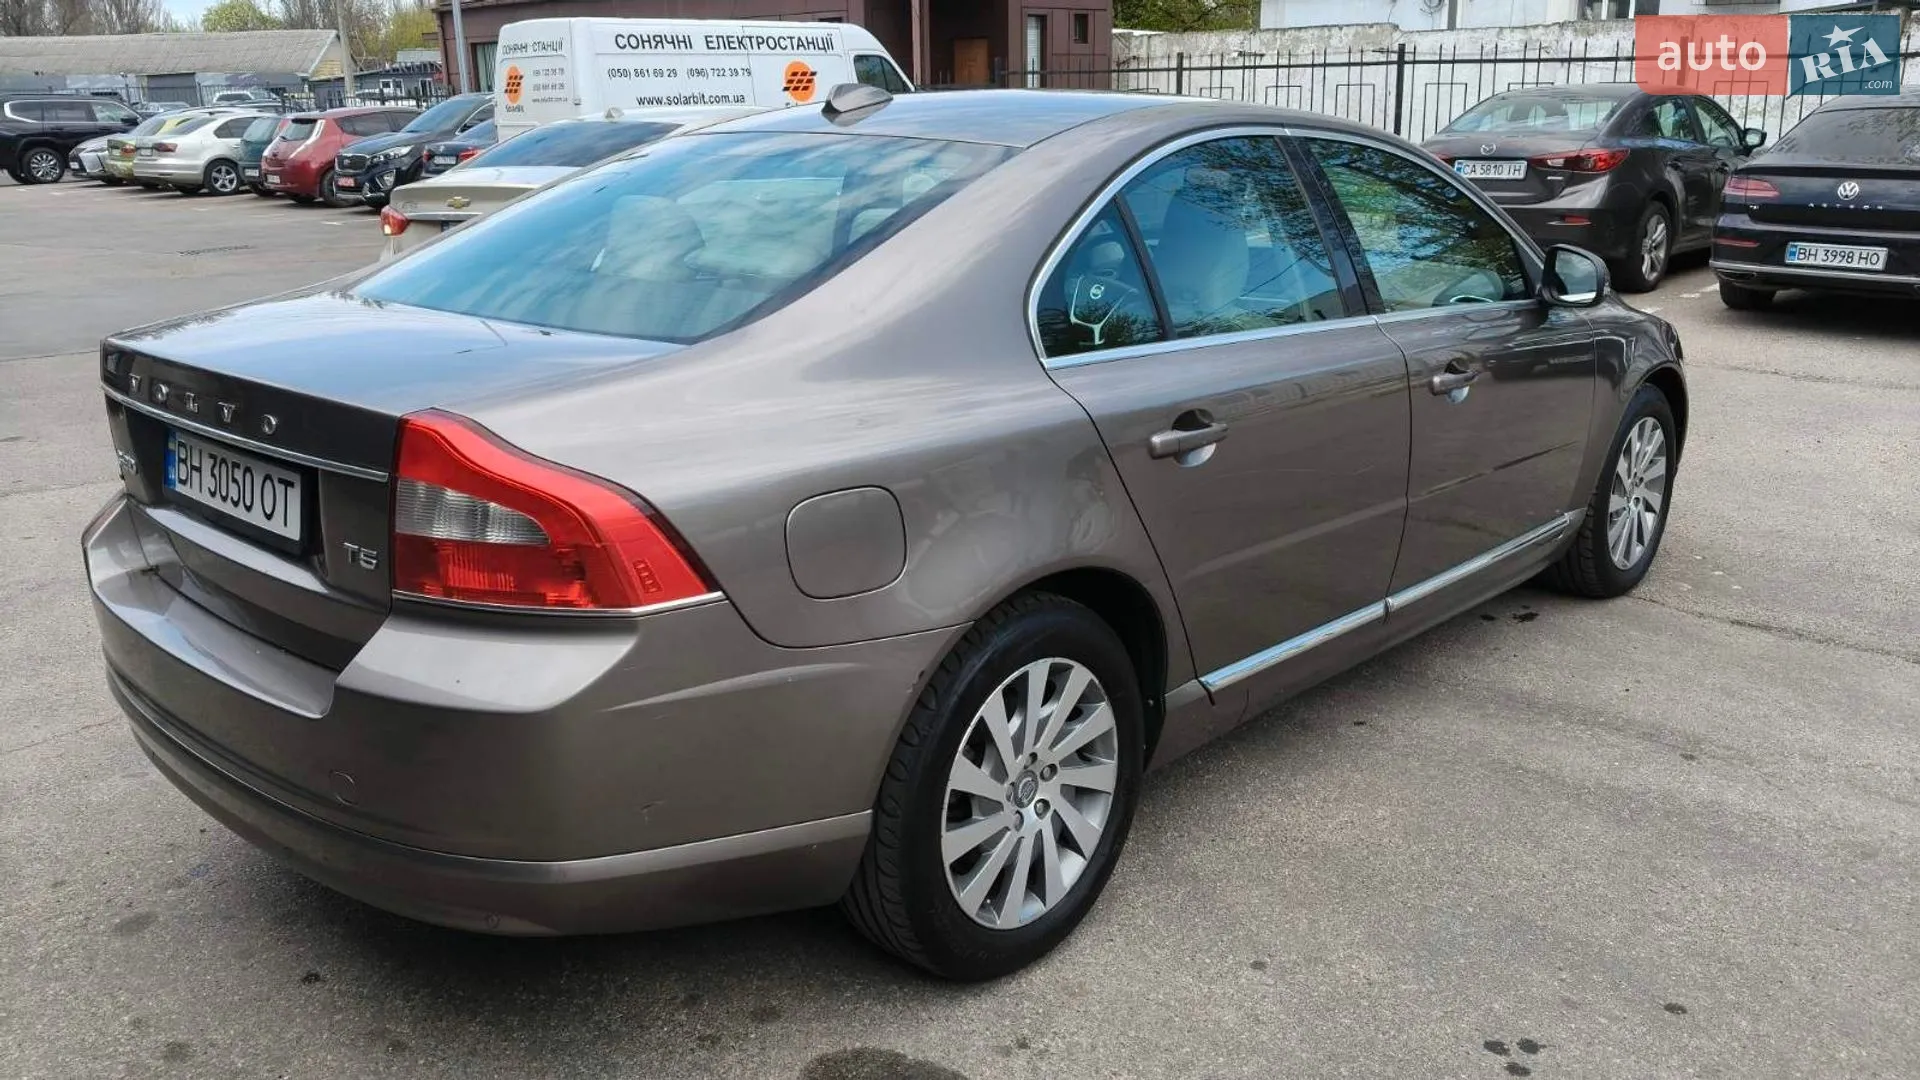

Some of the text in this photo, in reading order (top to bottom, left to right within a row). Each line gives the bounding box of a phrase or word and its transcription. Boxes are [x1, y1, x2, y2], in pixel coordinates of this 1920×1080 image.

[614, 33, 834, 53] СОНЯЧНІ ЕЛЕКТРОСТАНЦІЇ
[607, 67, 632, 80] (050)
[633, 68, 651, 78] 861
[666, 68, 678, 78] 29
[686, 67, 709, 80] (096)
[711, 67, 726, 77] 722
[729, 67, 740, 77] 39
[741, 67, 752, 78] 79
[636, 91, 746, 106] www.solarbit.com.ua
[1796, 247, 1880, 266] BH 3998 HO
[128, 372, 279, 435] VOLVO
[177, 440, 202, 494] BH
[207, 452, 255, 513] 3050
[260, 473, 295, 528] OT
[343, 541, 377, 570] T5
